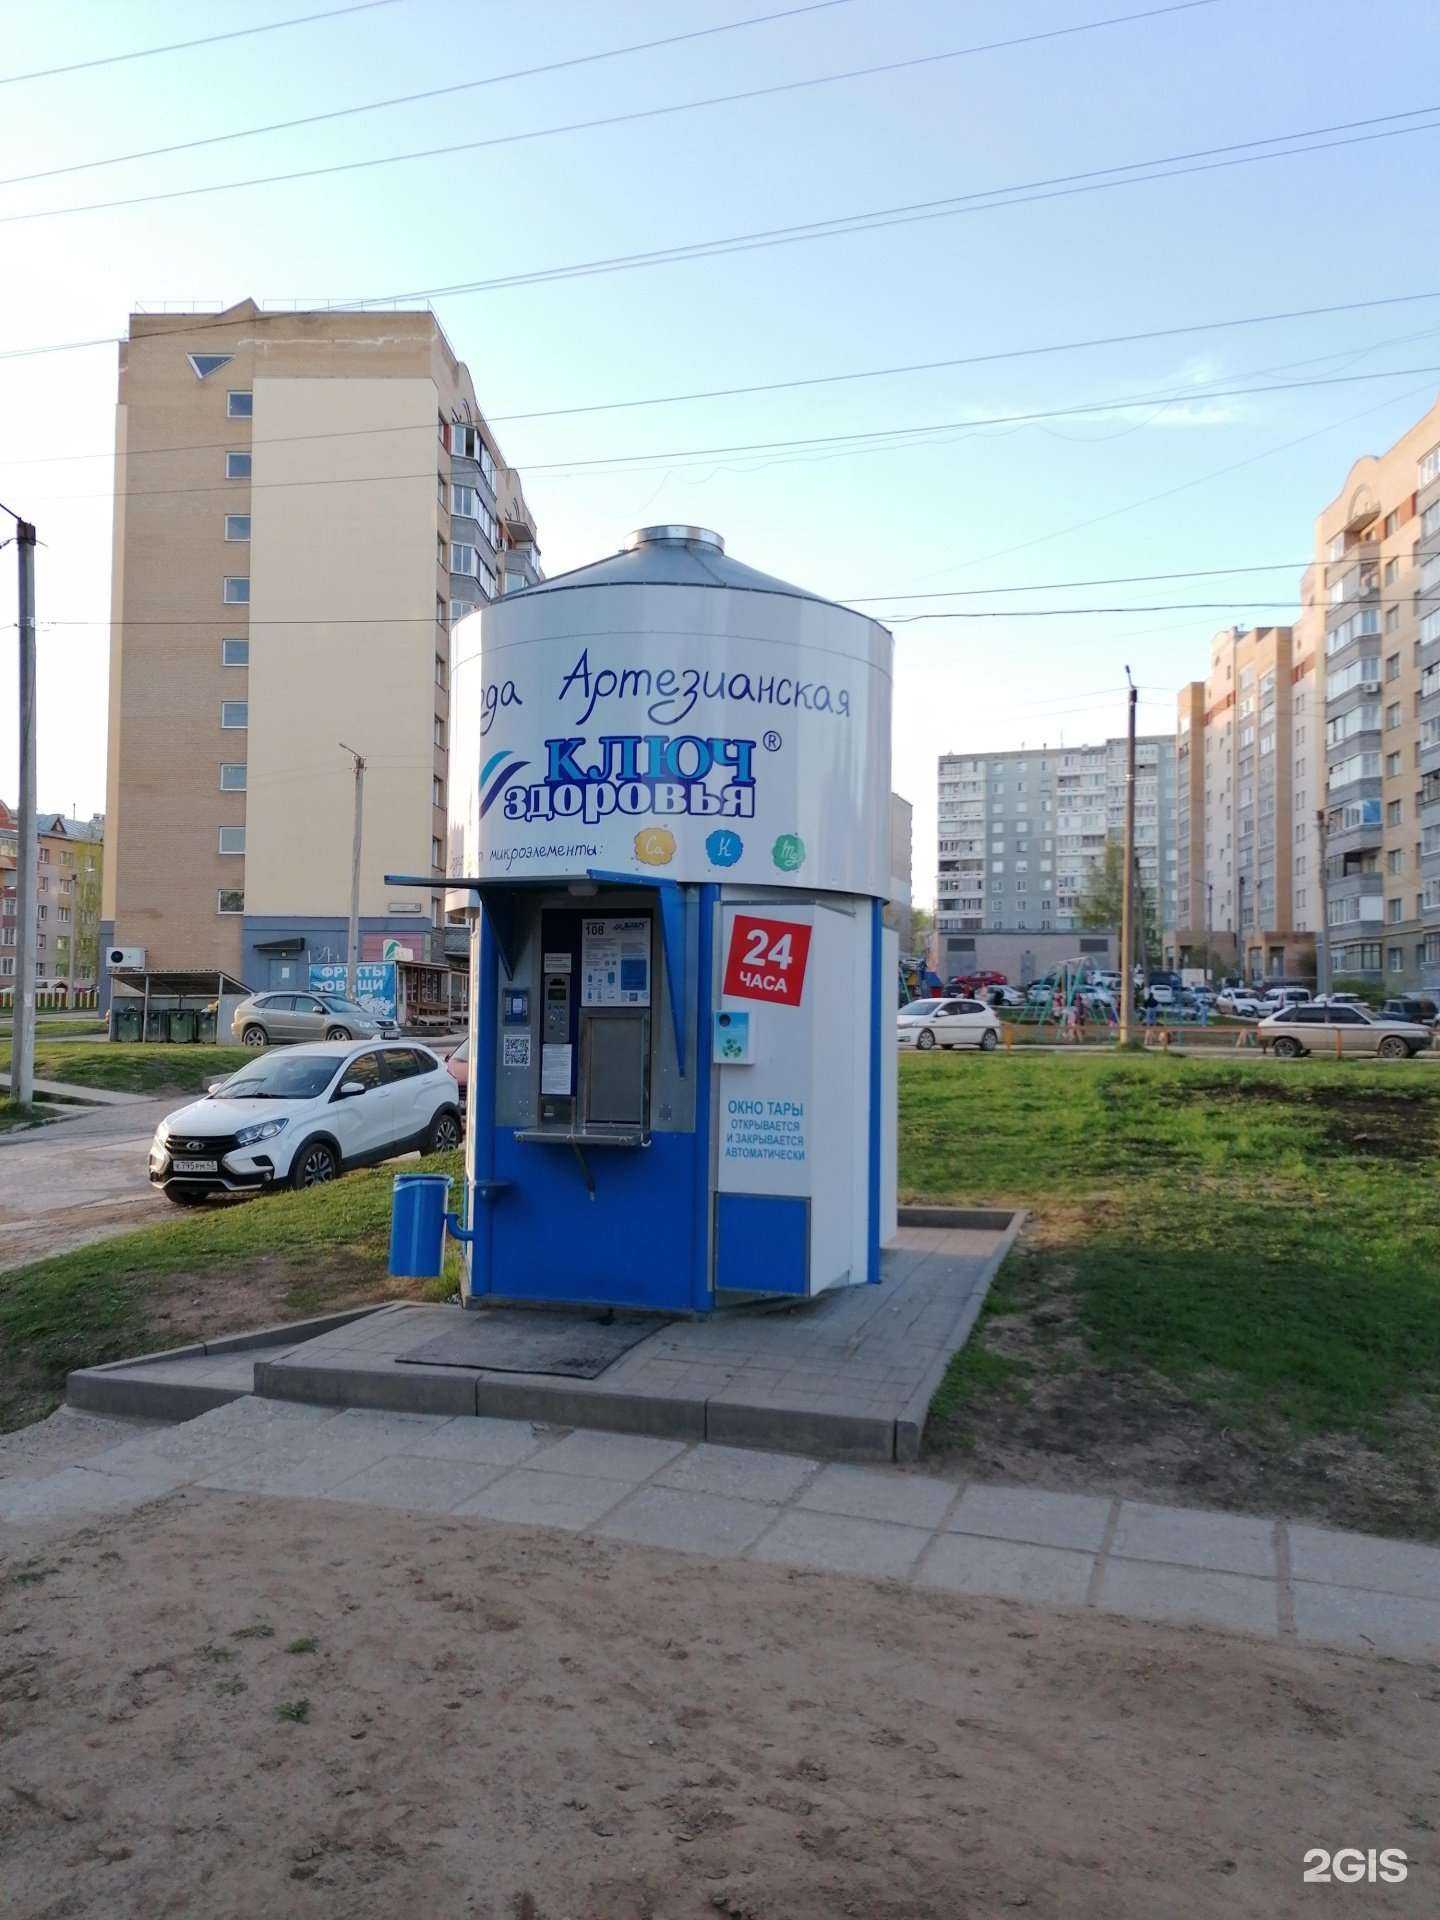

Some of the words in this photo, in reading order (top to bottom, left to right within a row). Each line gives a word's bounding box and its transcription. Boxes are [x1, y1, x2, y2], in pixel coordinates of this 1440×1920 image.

[559, 648, 850, 726] Артезианская
[544, 735, 756, 785] КЛЮЧ
[742, 929, 793, 970] 24
[739, 970, 788, 993] ЧАСА
[728, 1100, 763, 1115] ОКНО
[767, 1101, 803, 1117] ТАРЫ
[731, 1118, 800, 1132] ОТКРЫВАЕТСЯ
[726, 1133, 733, 1143] И
[736, 1133, 804, 1146] ЗАКРЫВАЕТСЯ
[725, 1147, 806, 1160] АВТОМАТИЧЕСКИ
